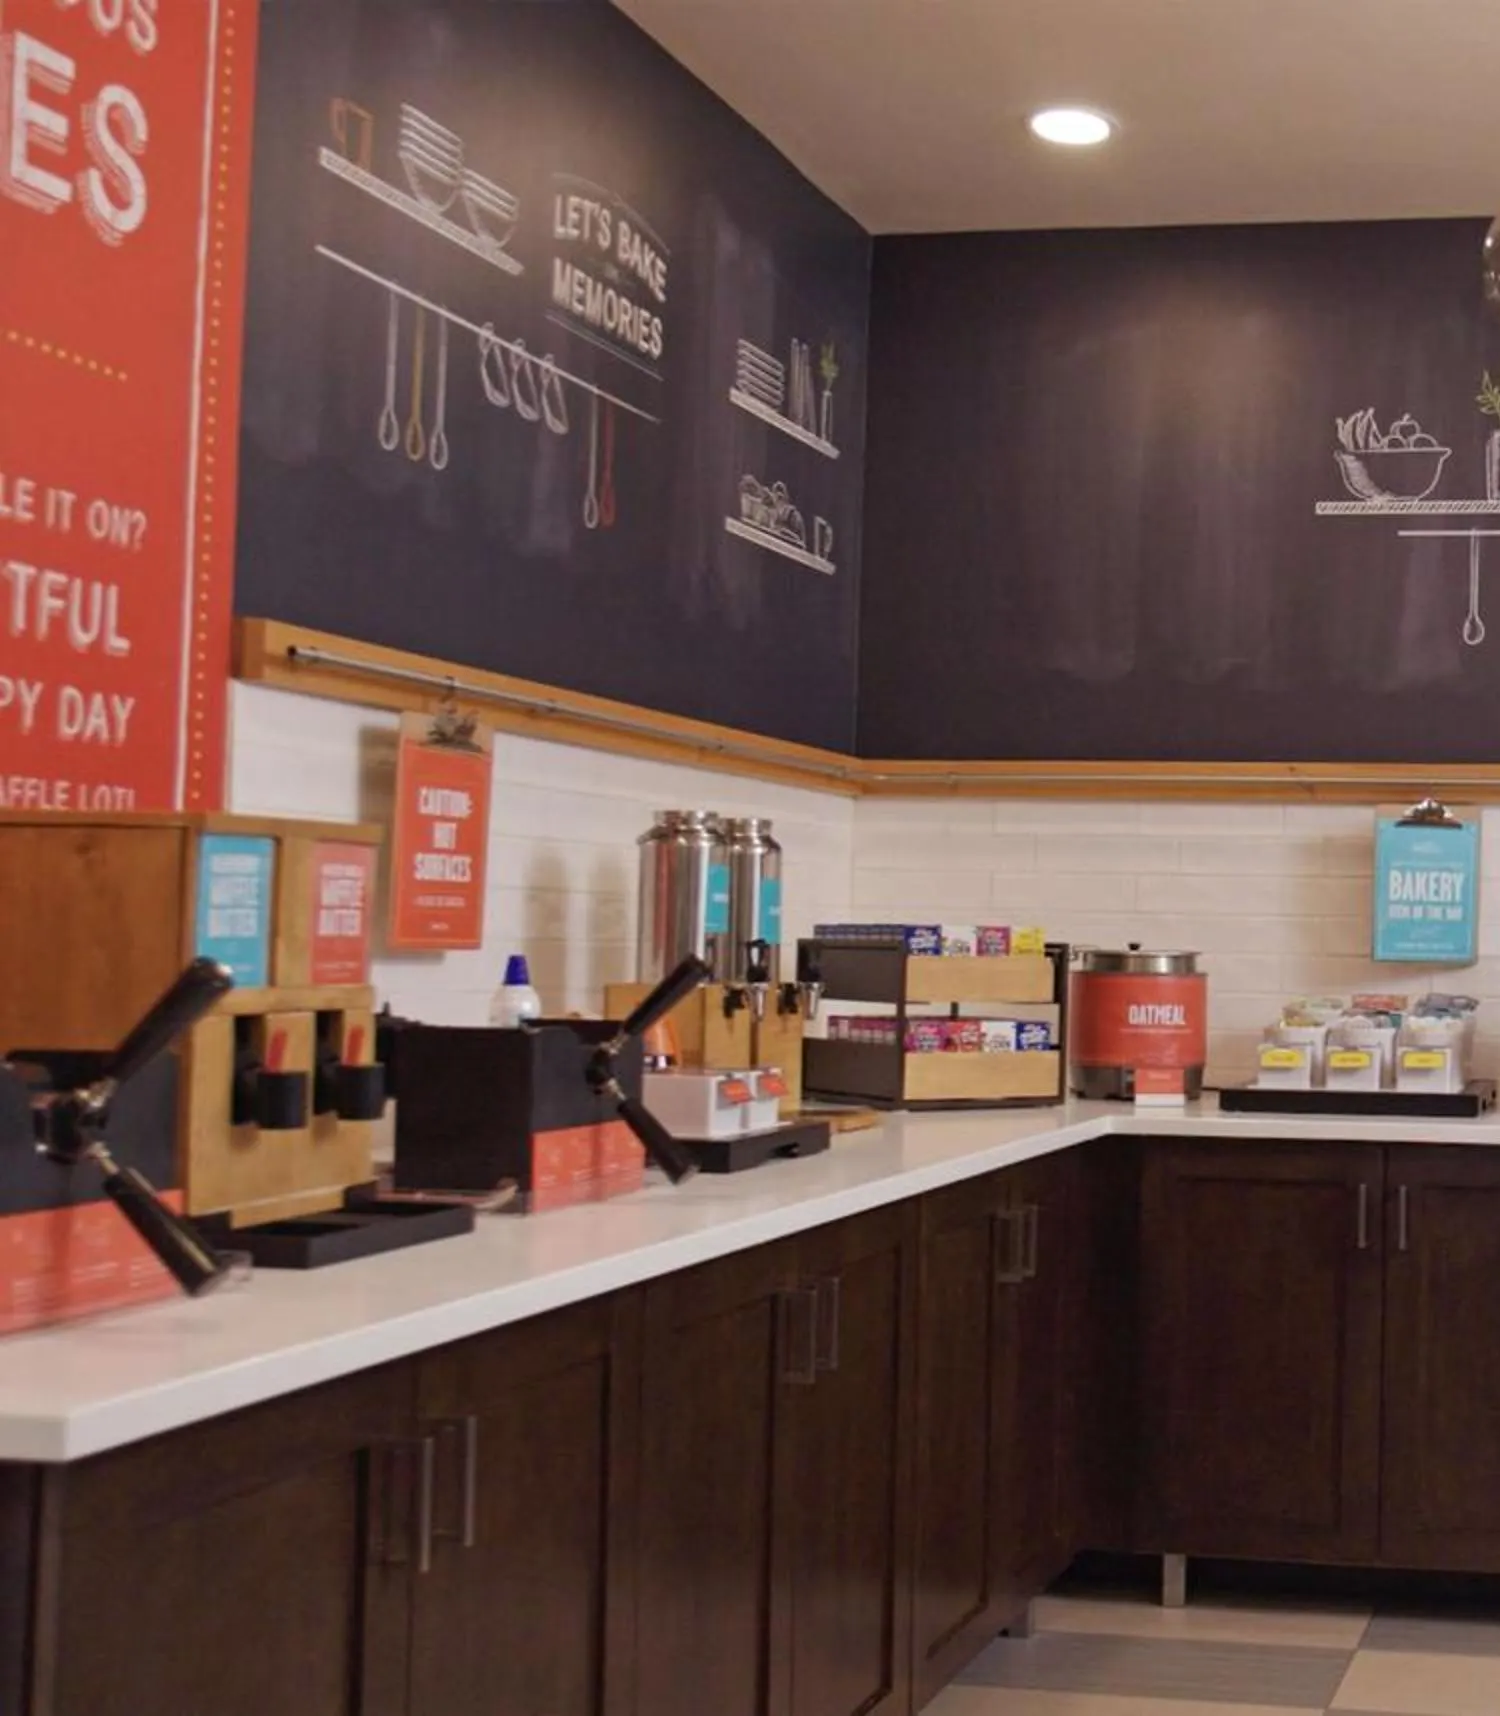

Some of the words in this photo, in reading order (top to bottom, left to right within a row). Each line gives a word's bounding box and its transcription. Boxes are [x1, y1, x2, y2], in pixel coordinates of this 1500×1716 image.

[553, 194, 612, 250] LET'S
[617, 220, 668, 303] BAKE
[553, 257, 664, 360] MEMORIES
[46, 486, 77, 533] IT
[86, 498, 147, 552] ON?
[5, 560, 132, 657] TFUL
[57, 684, 136, 748] DAY
[1389, 870, 1464, 902] BAKERY
[1128, 1004, 1186, 1026] OATMEAL
